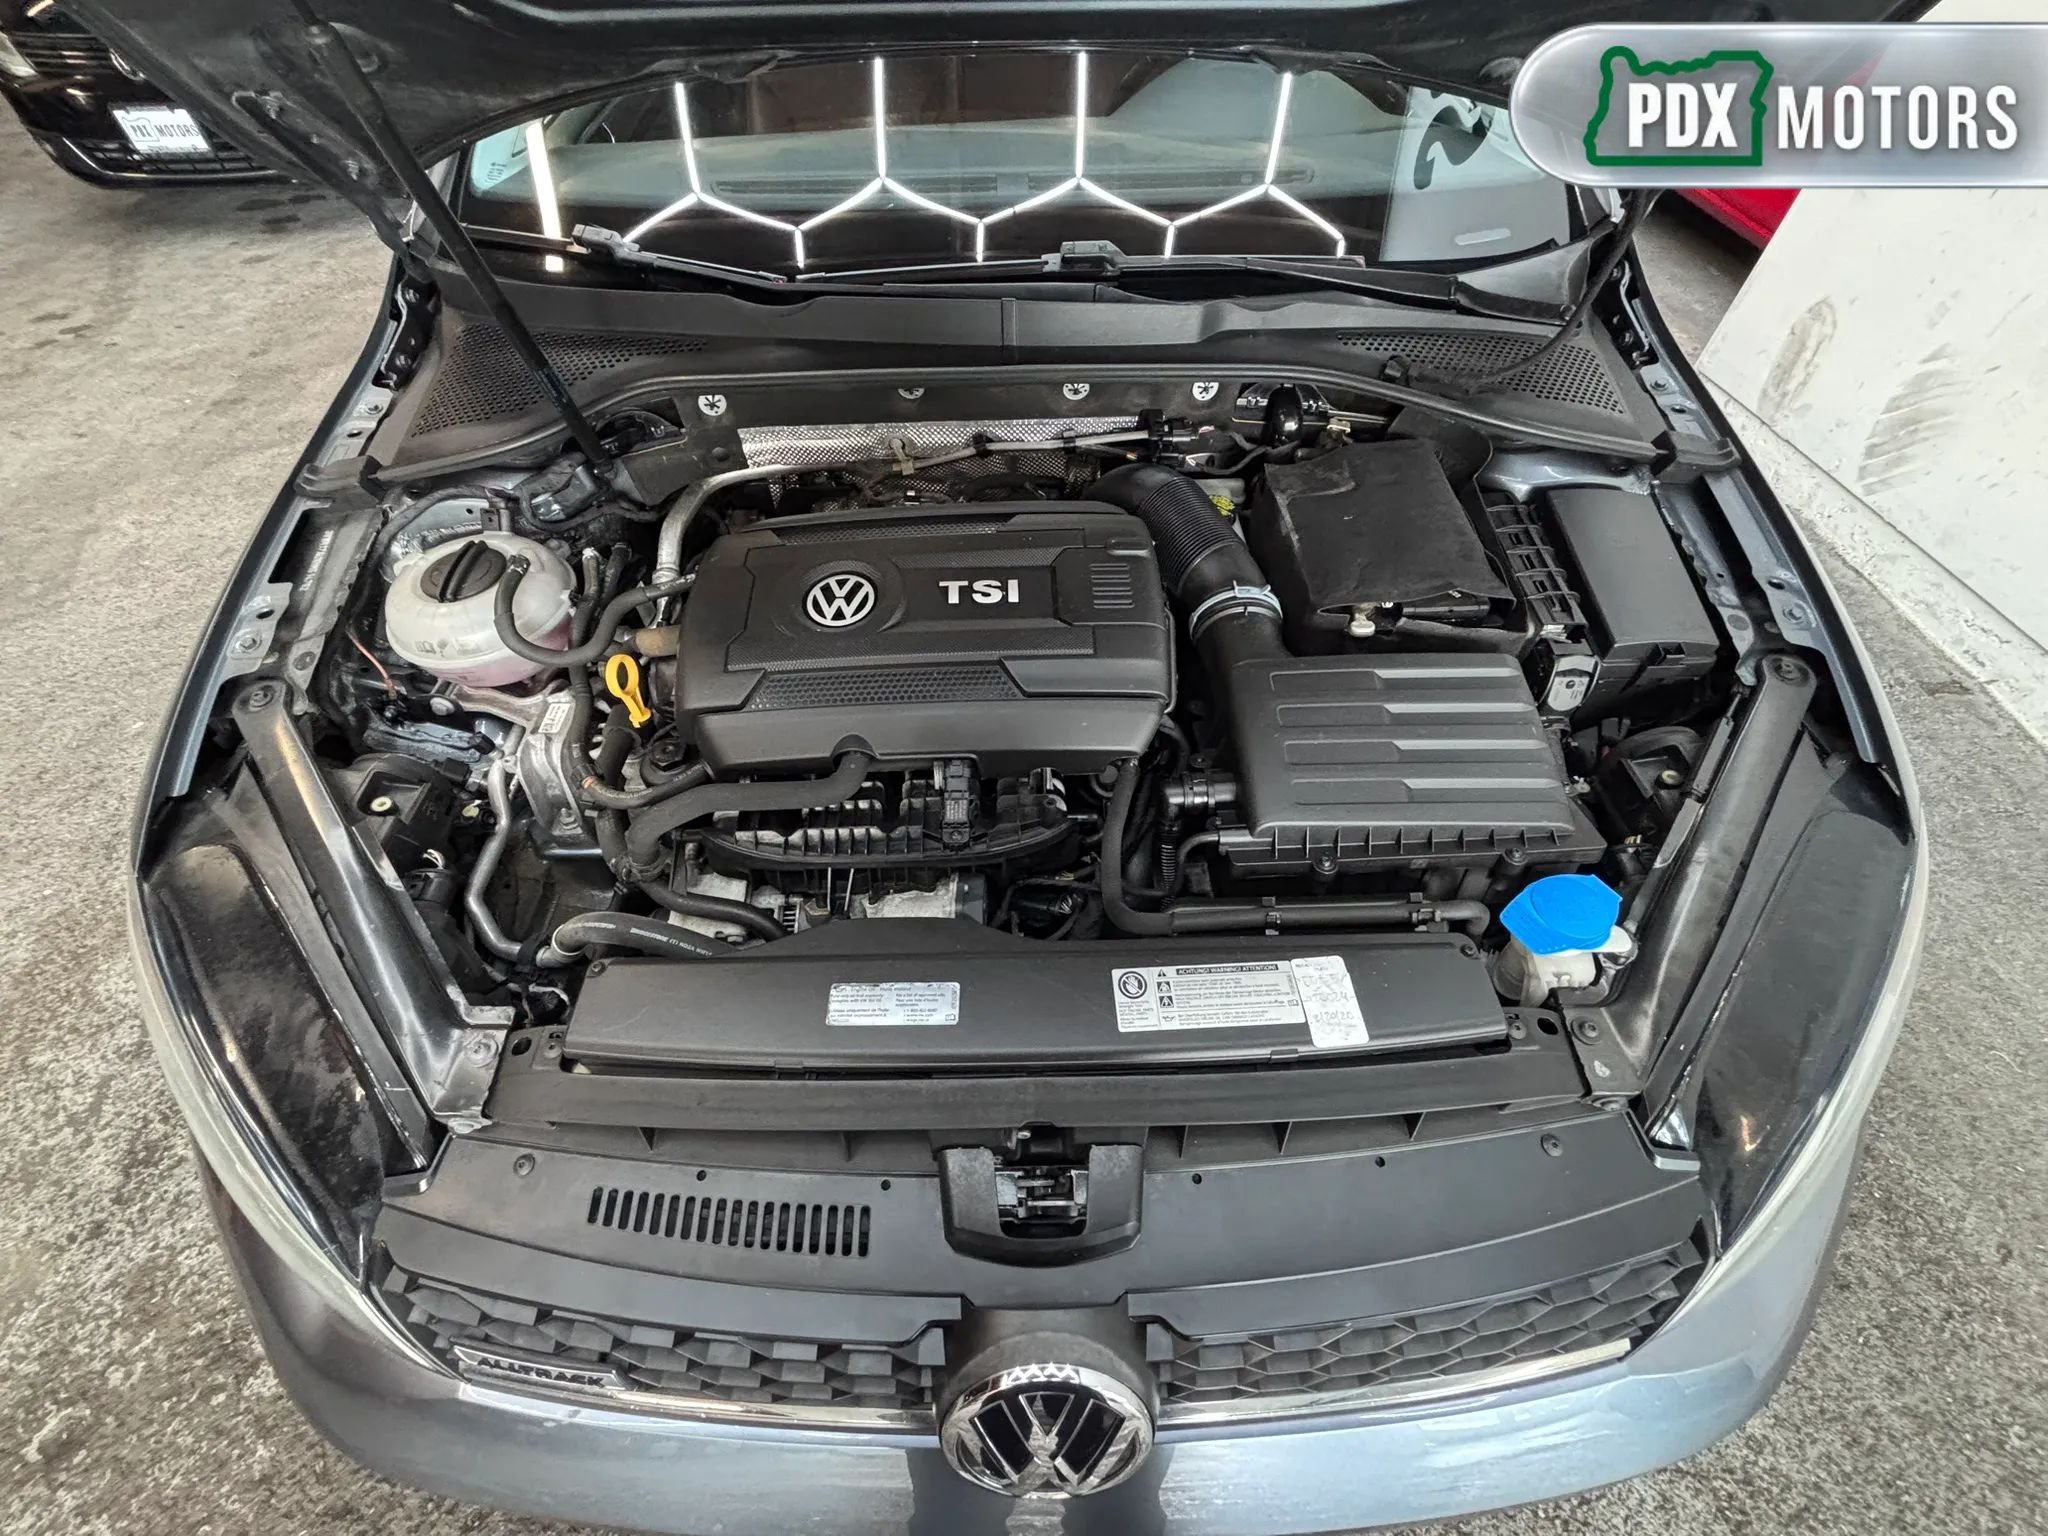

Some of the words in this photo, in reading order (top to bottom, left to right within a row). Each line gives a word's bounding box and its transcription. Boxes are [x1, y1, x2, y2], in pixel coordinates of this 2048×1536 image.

[154, 124, 200, 138] MOTORS
[807, 574, 876, 627] VW
[938, 578, 1020, 605] TSI
[1210, 965, 1242, 974] WARNING!
[476, 1357, 605, 1389] ALLTRACK
